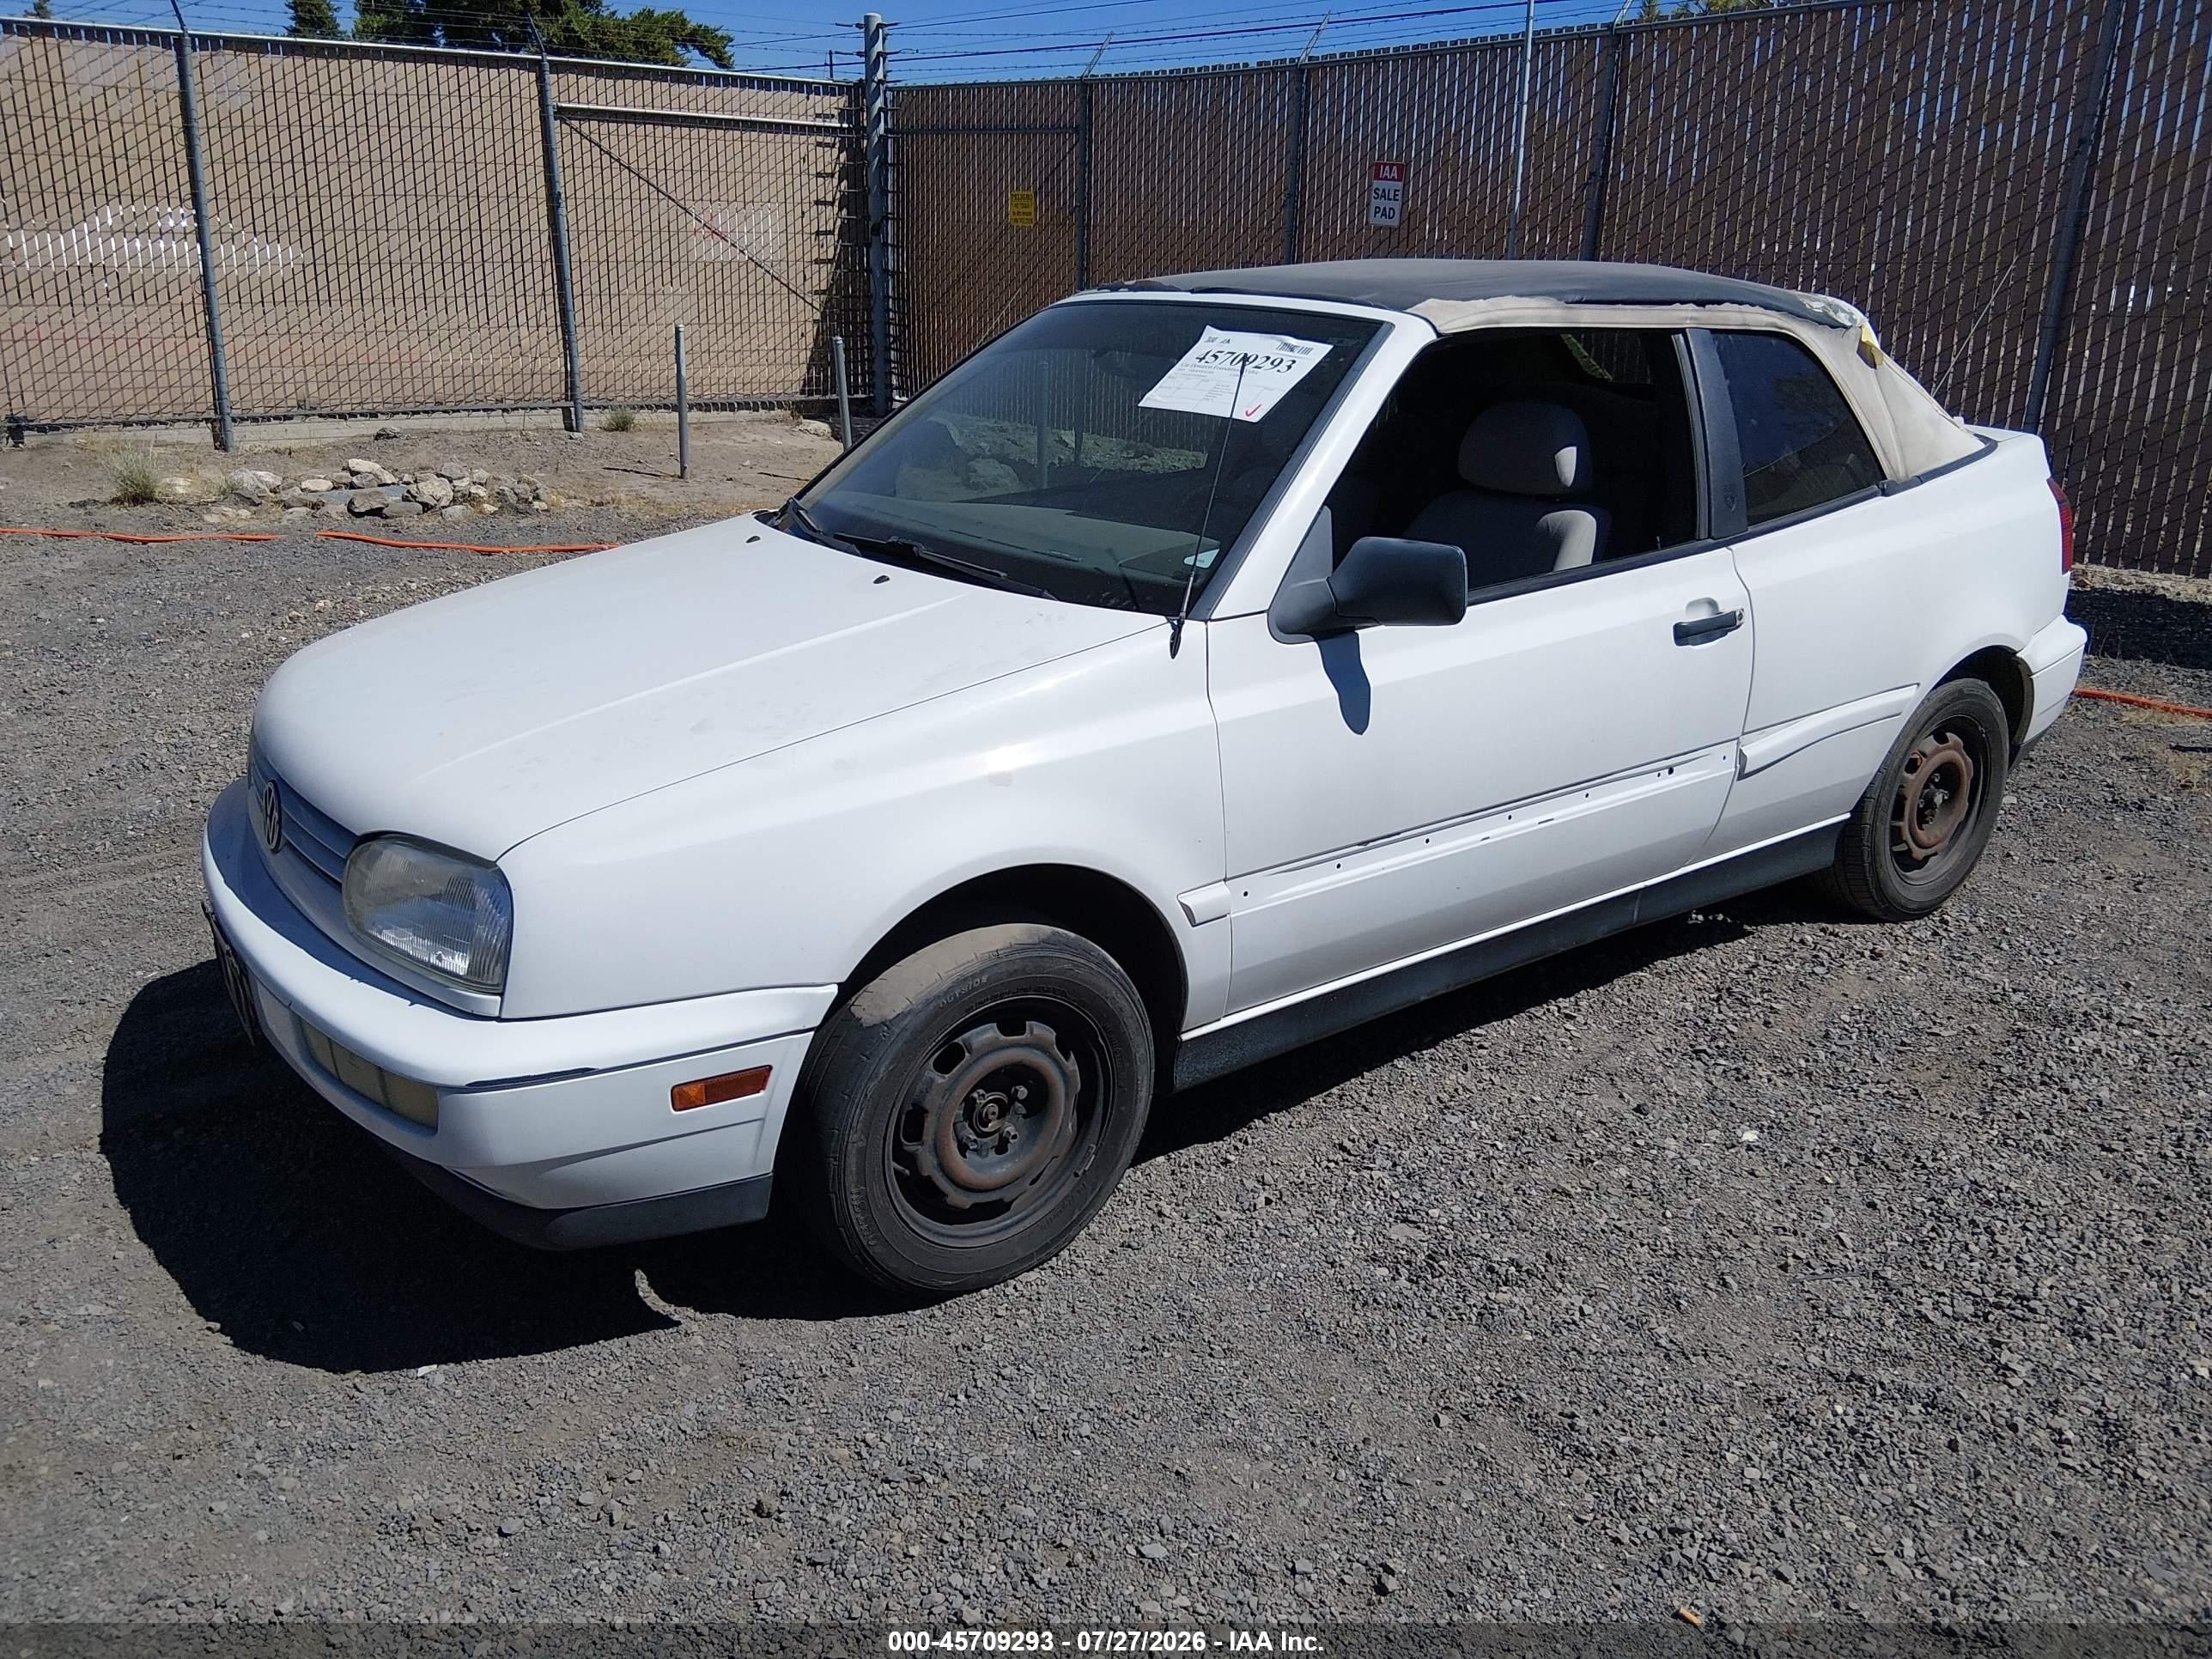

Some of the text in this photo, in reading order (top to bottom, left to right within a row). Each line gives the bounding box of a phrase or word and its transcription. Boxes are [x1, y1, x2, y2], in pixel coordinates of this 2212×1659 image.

[1379, 164, 1398, 179] IAA
[1373, 187, 1401, 202] SALE
[1374, 206, 1396, 220] PAD
[1194, 349, 1297, 374] 45709293
